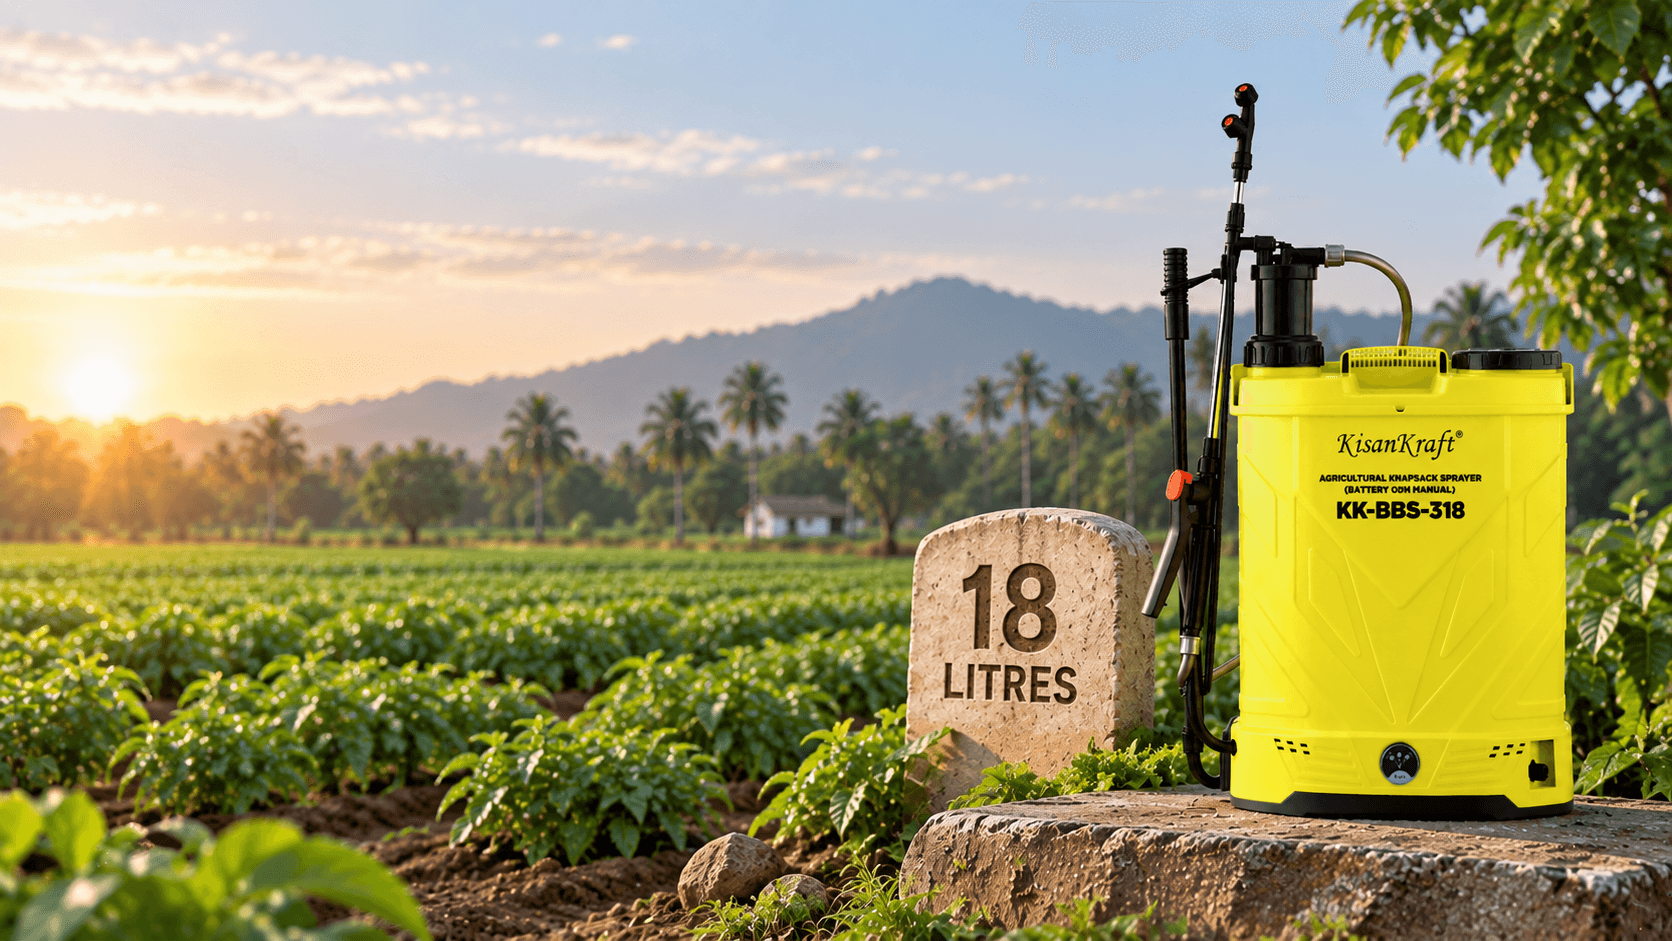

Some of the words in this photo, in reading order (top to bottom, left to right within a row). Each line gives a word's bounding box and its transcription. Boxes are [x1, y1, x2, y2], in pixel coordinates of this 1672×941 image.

[1319, 474, 1388, 483] AGRICULTURAL
[1388, 474, 1439, 483] KNAPSACK
[1440, 474, 1483, 483] SPRAYER
[1344, 486, 1389, 495] (BATTERY
[1412, 485, 1456, 495] MANUAL)
[1337, 500, 1466, 520] KK-BBS-318
[962, 562, 1058, 653] 18
[943, 662, 1078, 705] LITRES
